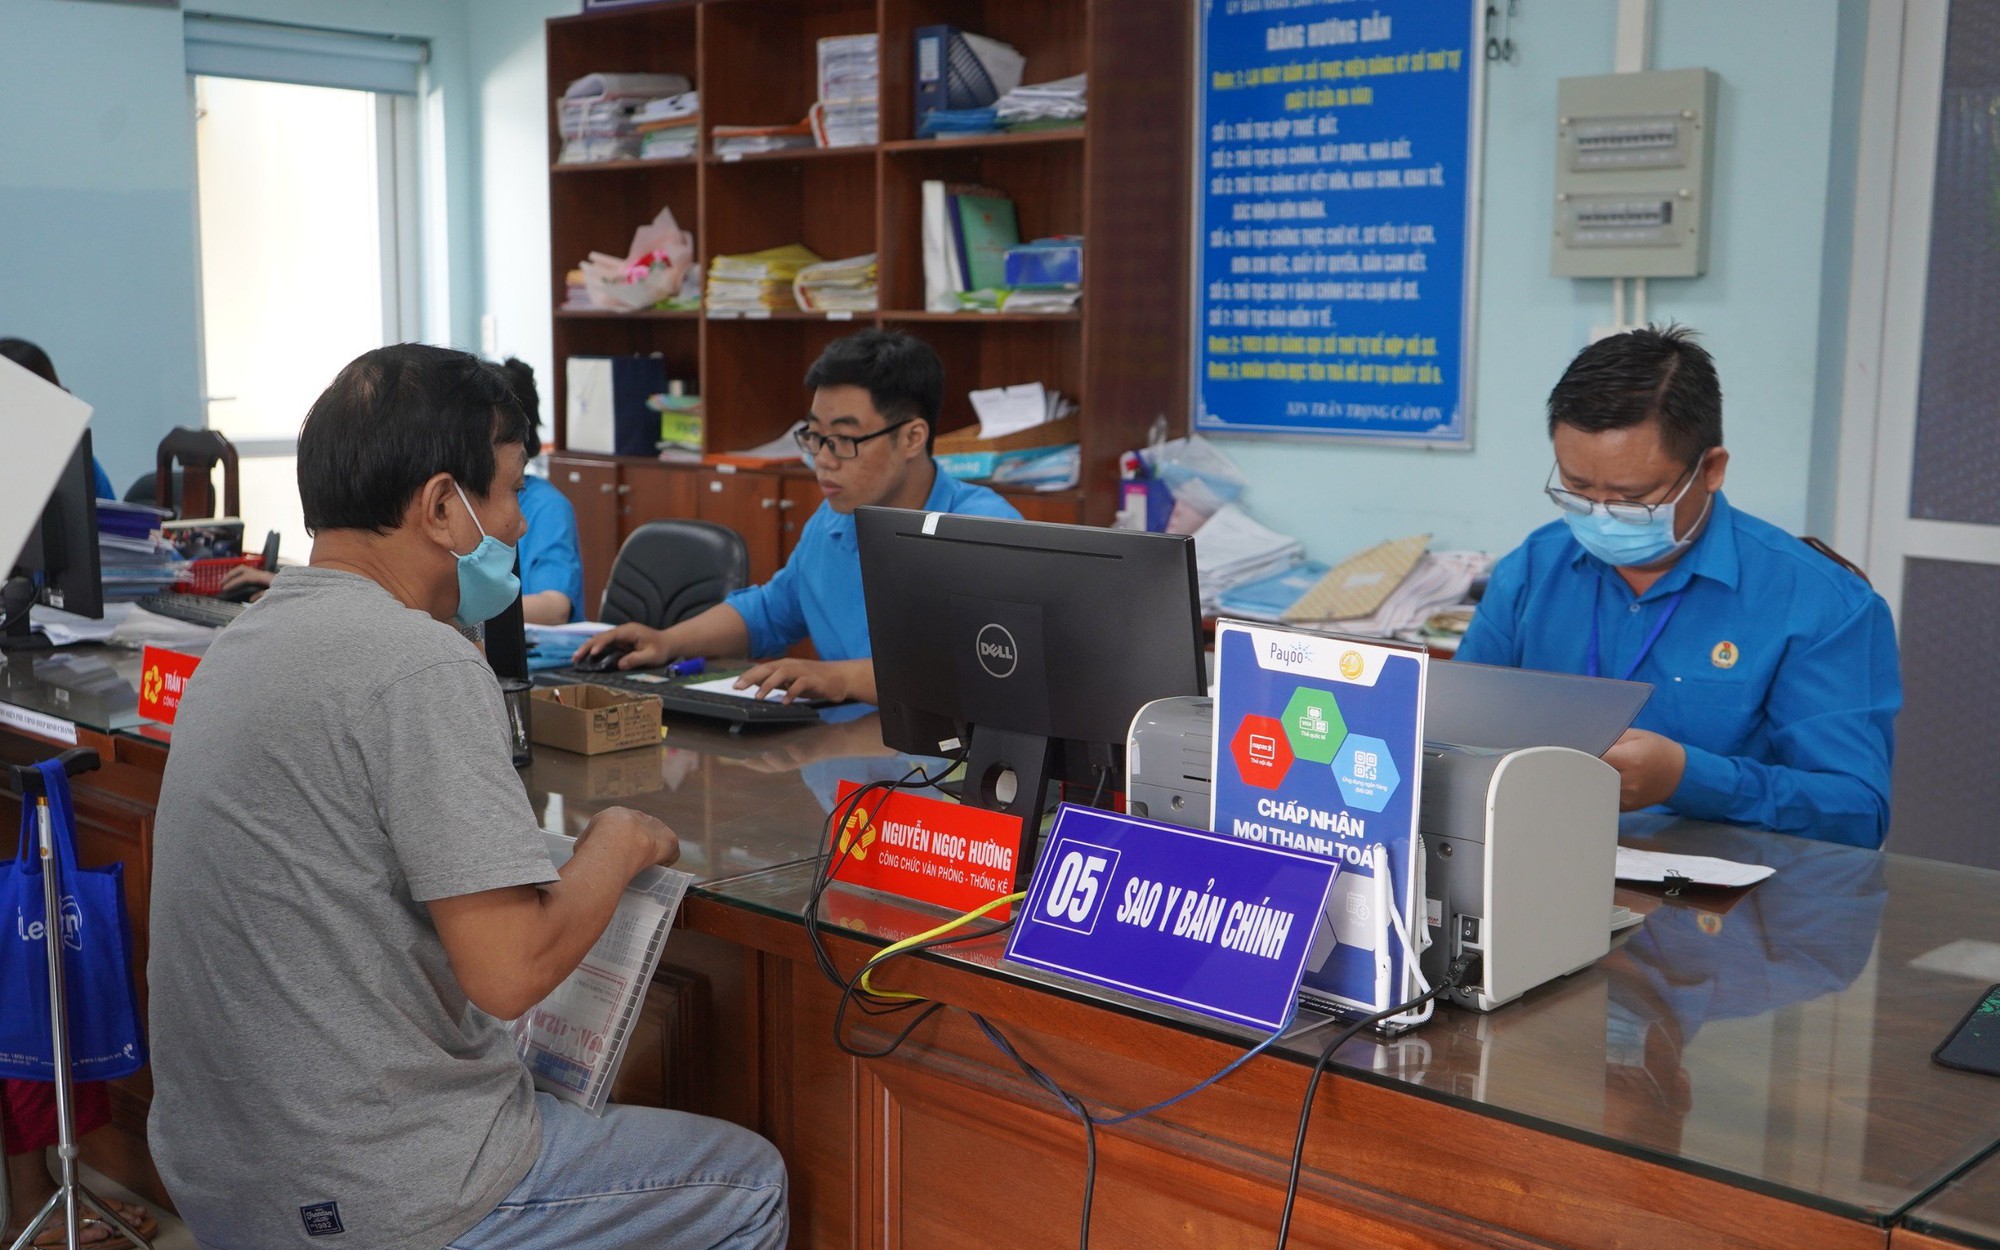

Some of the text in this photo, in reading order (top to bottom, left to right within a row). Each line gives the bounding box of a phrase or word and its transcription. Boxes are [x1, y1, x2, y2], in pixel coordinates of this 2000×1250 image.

[981, 642, 1013, 659] DELL
[1270, 642, 1304, 666] Payoo
[1257, 798, 1365, 839] CHẤP NHẬN
[881, 820, 1012, 871] NGUYỄN NGỌC HƯỜNG
[1269, 827, 1333, 855] THANH
[1335, 842, 1375, 869] TOÁ
[878, 852, 1008, 894] CÔNG CHỨC VĂN PHÒNG THỐNG KÊ
[1046, 851, 1107, 923] 05
[1117, 876, 1296, 960] SAO Y BẢN CHÍNH
